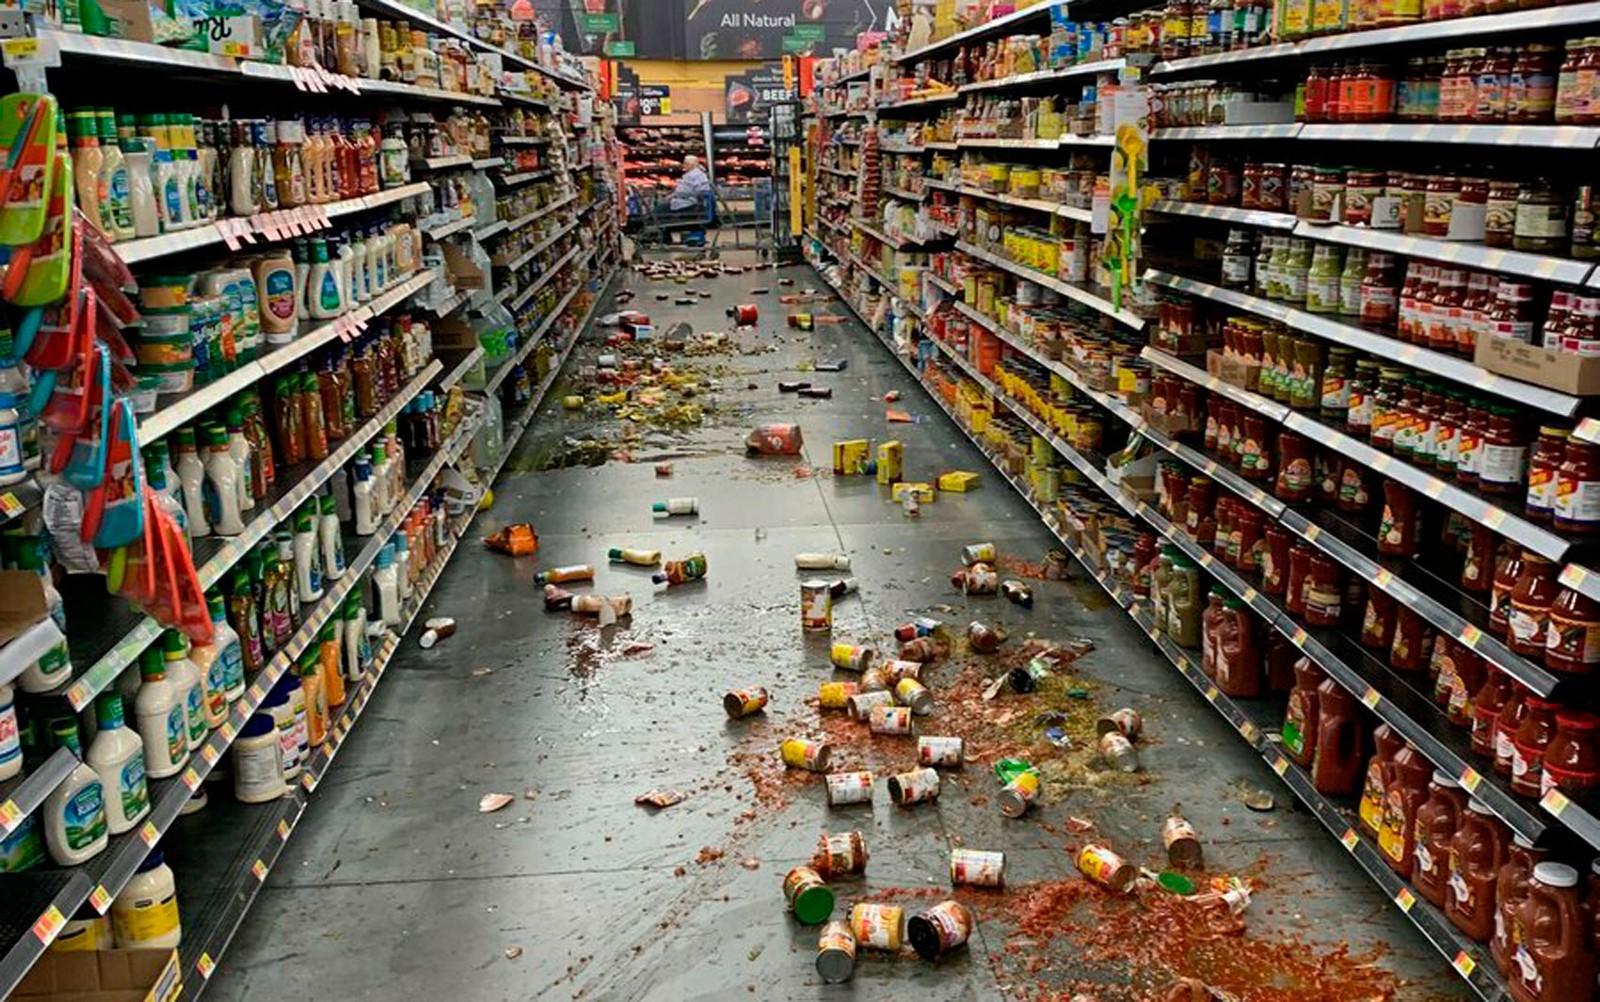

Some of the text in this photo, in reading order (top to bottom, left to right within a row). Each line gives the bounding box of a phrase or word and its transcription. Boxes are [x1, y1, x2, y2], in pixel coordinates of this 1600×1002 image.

[720, 12, 796, 28] All Natural
[763, 89, 792, 101] BEEF
